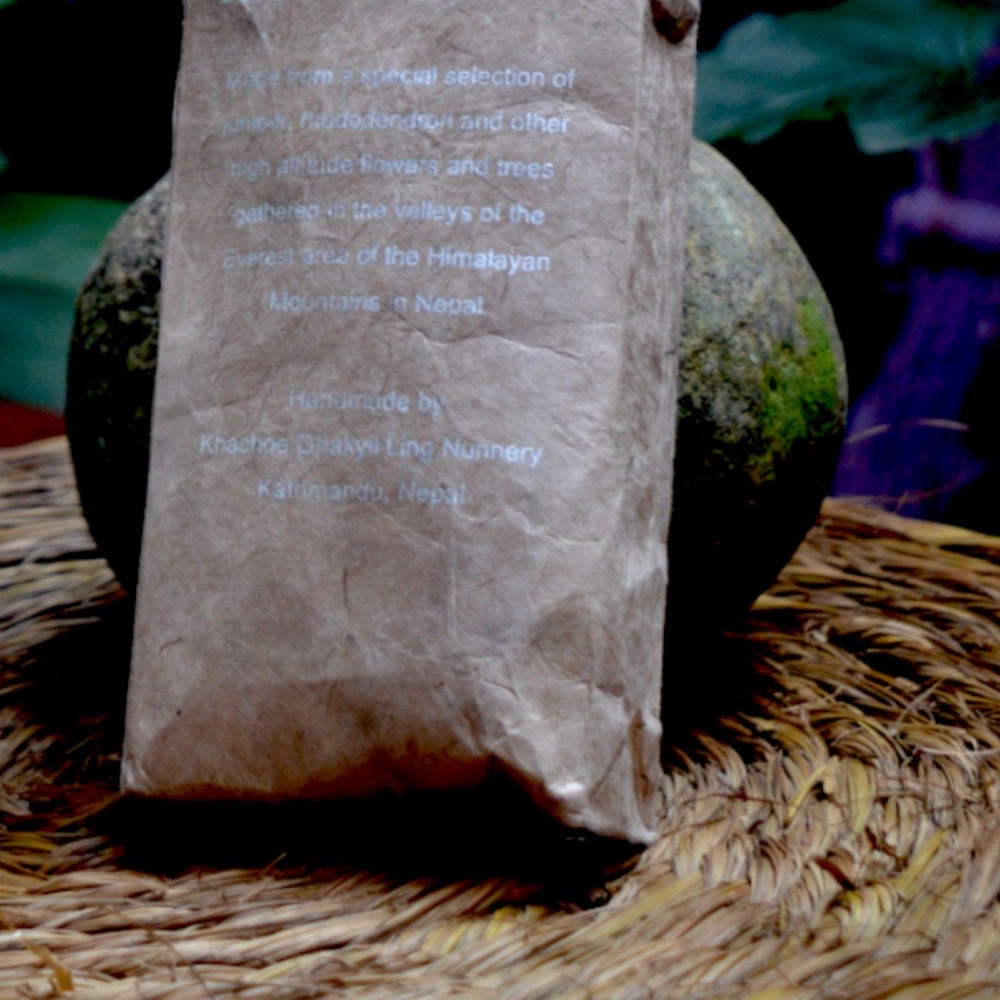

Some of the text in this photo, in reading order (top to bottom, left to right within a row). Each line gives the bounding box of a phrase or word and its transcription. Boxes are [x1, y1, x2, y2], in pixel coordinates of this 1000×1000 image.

[287, 67, 333, 86] from
[341, 69, 353, 85] a
[360, 66, 438, 88] special
[444, 66, 546, 88] selection
[552, 68, 575, 89] of
[460, 113, 504, 132] and
[511, 113, 571, 134] other
[360, 152, 439, 175] flowers
[446, 155, 488, 176] and
[497, 158, 555, 179] trees
[233, 202, 320, 227] gathered
[352, 200, 387, 220] the
[394, 200, 472, 225] valleys
[480, 203, 503, 223] of
[509, 203, 545, 225] the
[356, 244, 381, 265] of
[384, 244, 419, 266] the
[427, 247, 549, 274] Himalayan
[415, 293, 484, 316] Nepal
[418, 390, 445, 418] by
[442, 436, 543, 467] Nunnery
[400, 481, 466, 505] Nepal
